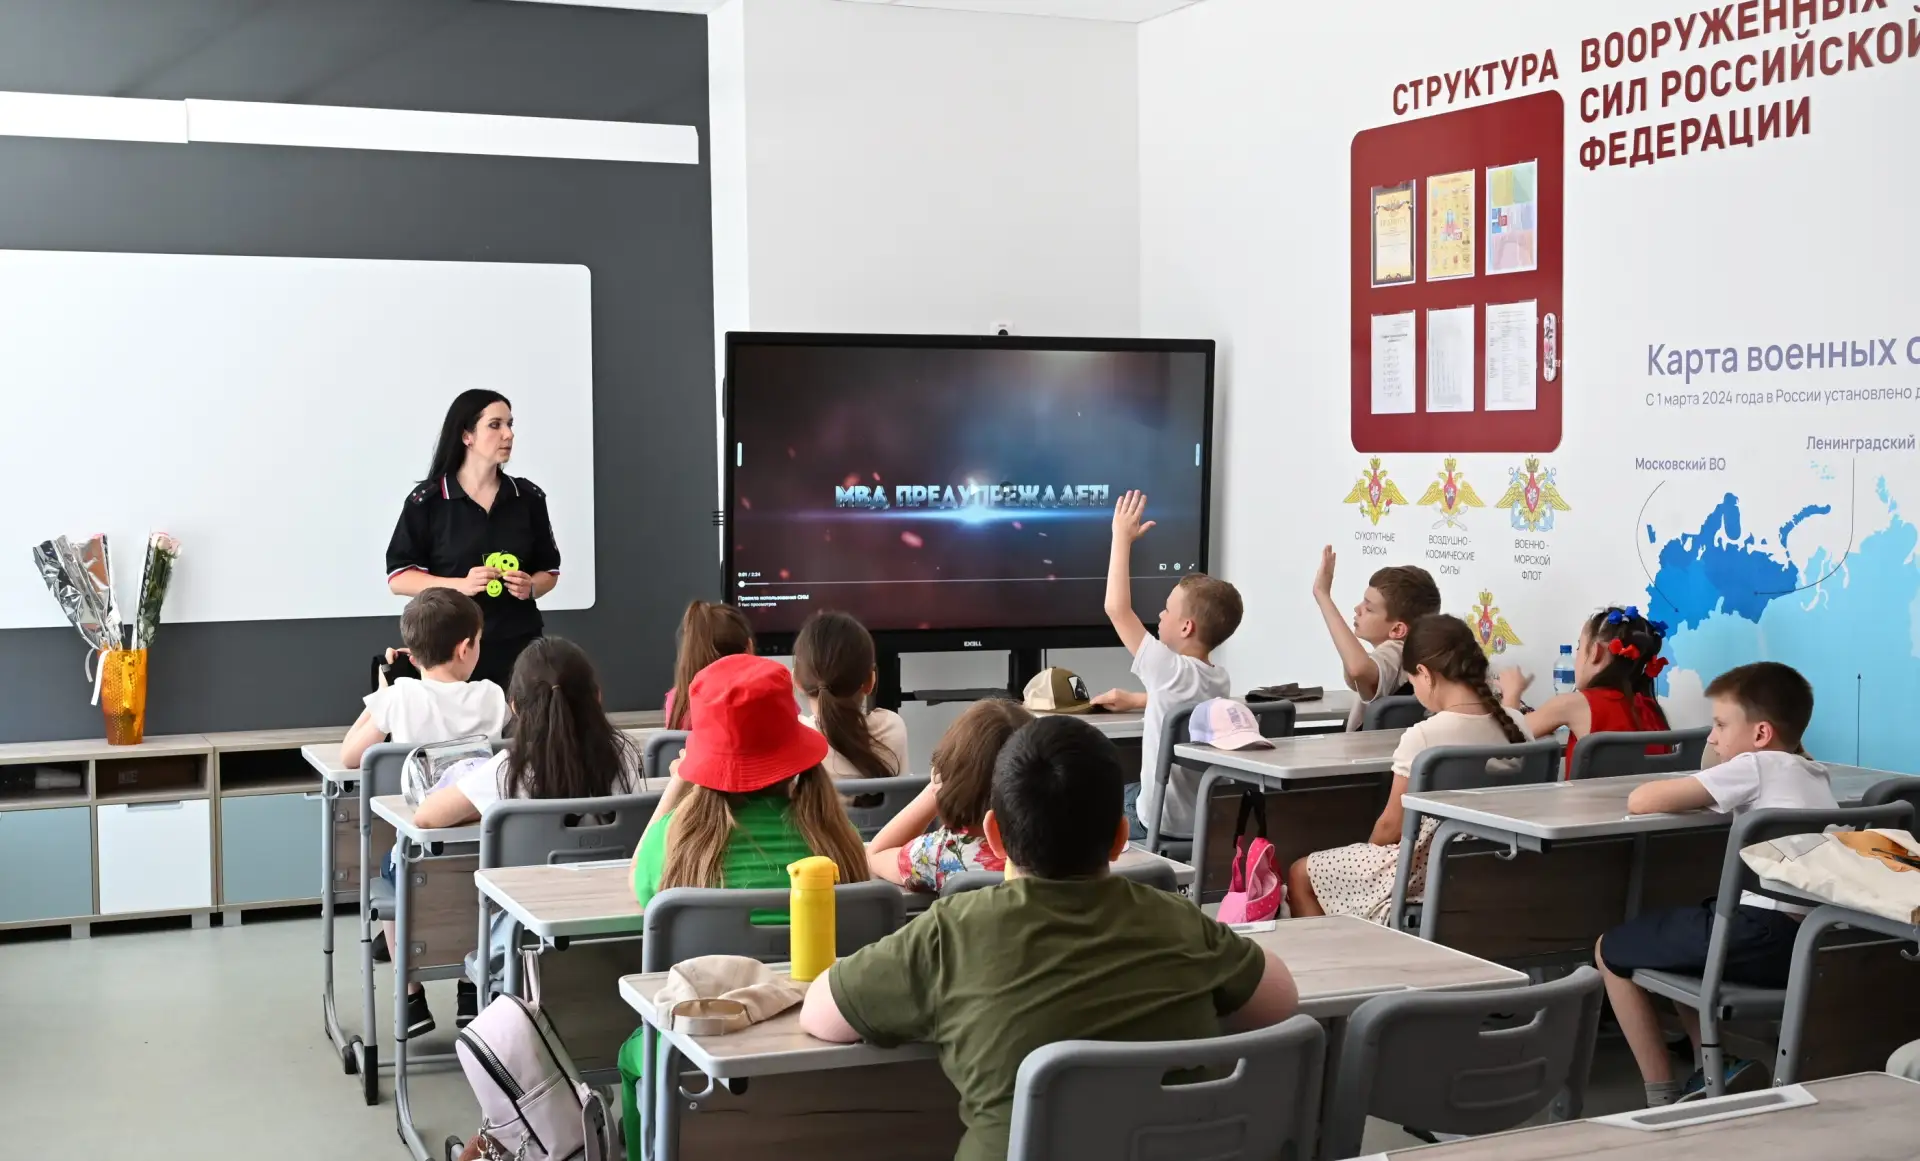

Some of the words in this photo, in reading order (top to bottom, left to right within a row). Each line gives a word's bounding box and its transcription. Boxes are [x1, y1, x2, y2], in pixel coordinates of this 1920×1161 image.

[1581, 0, 1888, 73] ВООРУЖЕННЫ
[1393, 48, 1559, 115] СТРУКТУРА
[1580, 77, 1647, 123] СИЛ
[1579, 96, 1810, 171] ФЕДЕРАЦИИ
[1647, 344, 1738, 384] Карта
[1747, 338, 1897, 372] военных
[1657, 393, 1662, 405] 1
[1664, 394, 1700, 409] марта
[1702, 391, 1733, 405] 2024
[1735, 391, 1764, 405] года
[1766, 392, 1774, 403] в
[1775, 388, 1821, 404] России
[1824, 387, 1912, 406] установлено
[1806, 434, 1916, 454] Ленинградский
[1635, 457, 1707, 471] Московский
[1709, 457, 1726, 471] ВО
[835, 484, 890, 509] МВД
[1354, 531, 1396, 542] СУХОПУТНЫЕ
[1362, 545, 1387, 556] ВОЙСКА
[1425, 549, 1475, 561] КОСМИЧЕСКИЕ
[1514, 554, 1551, 566] МОРСКОЙ
[1440, 564, 1460, 575] СИЛЫ
[1521, 570, 1542, 581] ФЛОТ
